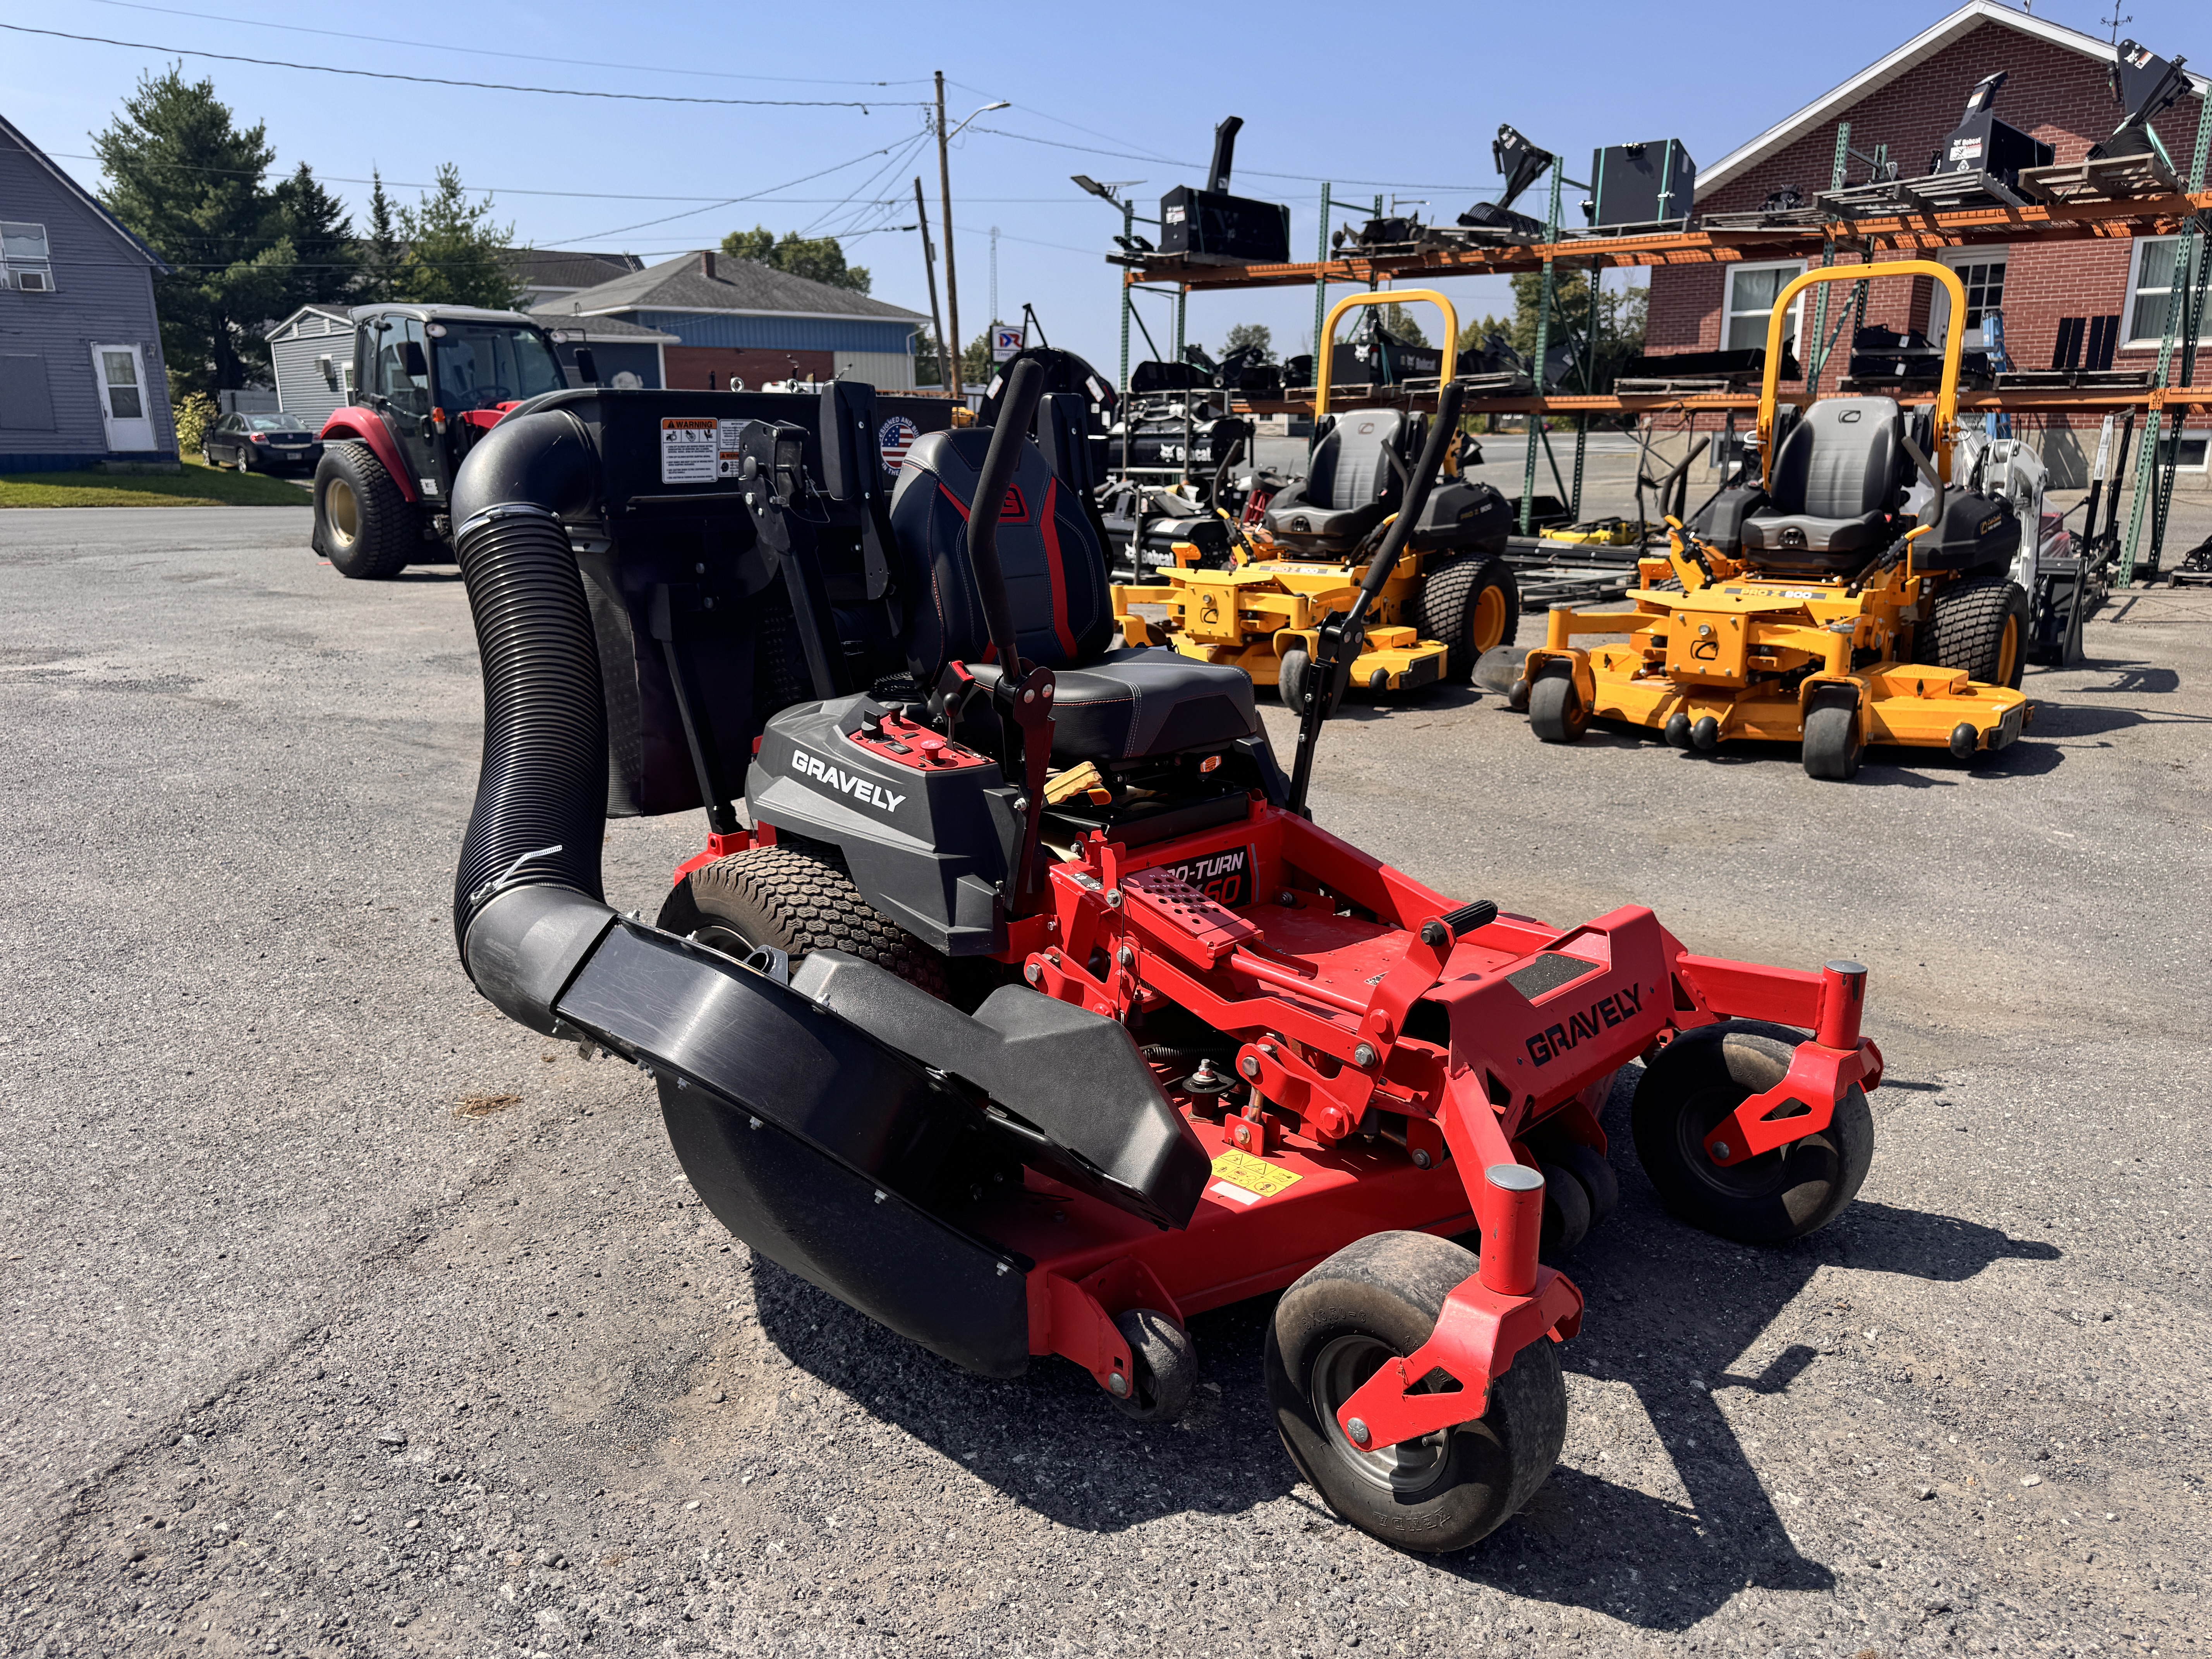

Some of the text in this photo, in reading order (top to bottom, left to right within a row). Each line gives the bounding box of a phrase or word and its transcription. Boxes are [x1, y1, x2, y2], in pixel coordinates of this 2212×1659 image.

[900, 417, 912, 427] AND
[912, 425, 920, 438] BUI
[1176, 446, 1212, 462] Bbcat
[881, 462, 888, 471] IN
[1141, 548, 1175, 567] Bobcat
[1740, 588, 1768, 596] PRO
[1784, 590, 1812, 599] 900
[792, 749, 906, 812] GRAVELY
[1525, 982, 1643, 1067] GRAVELY
